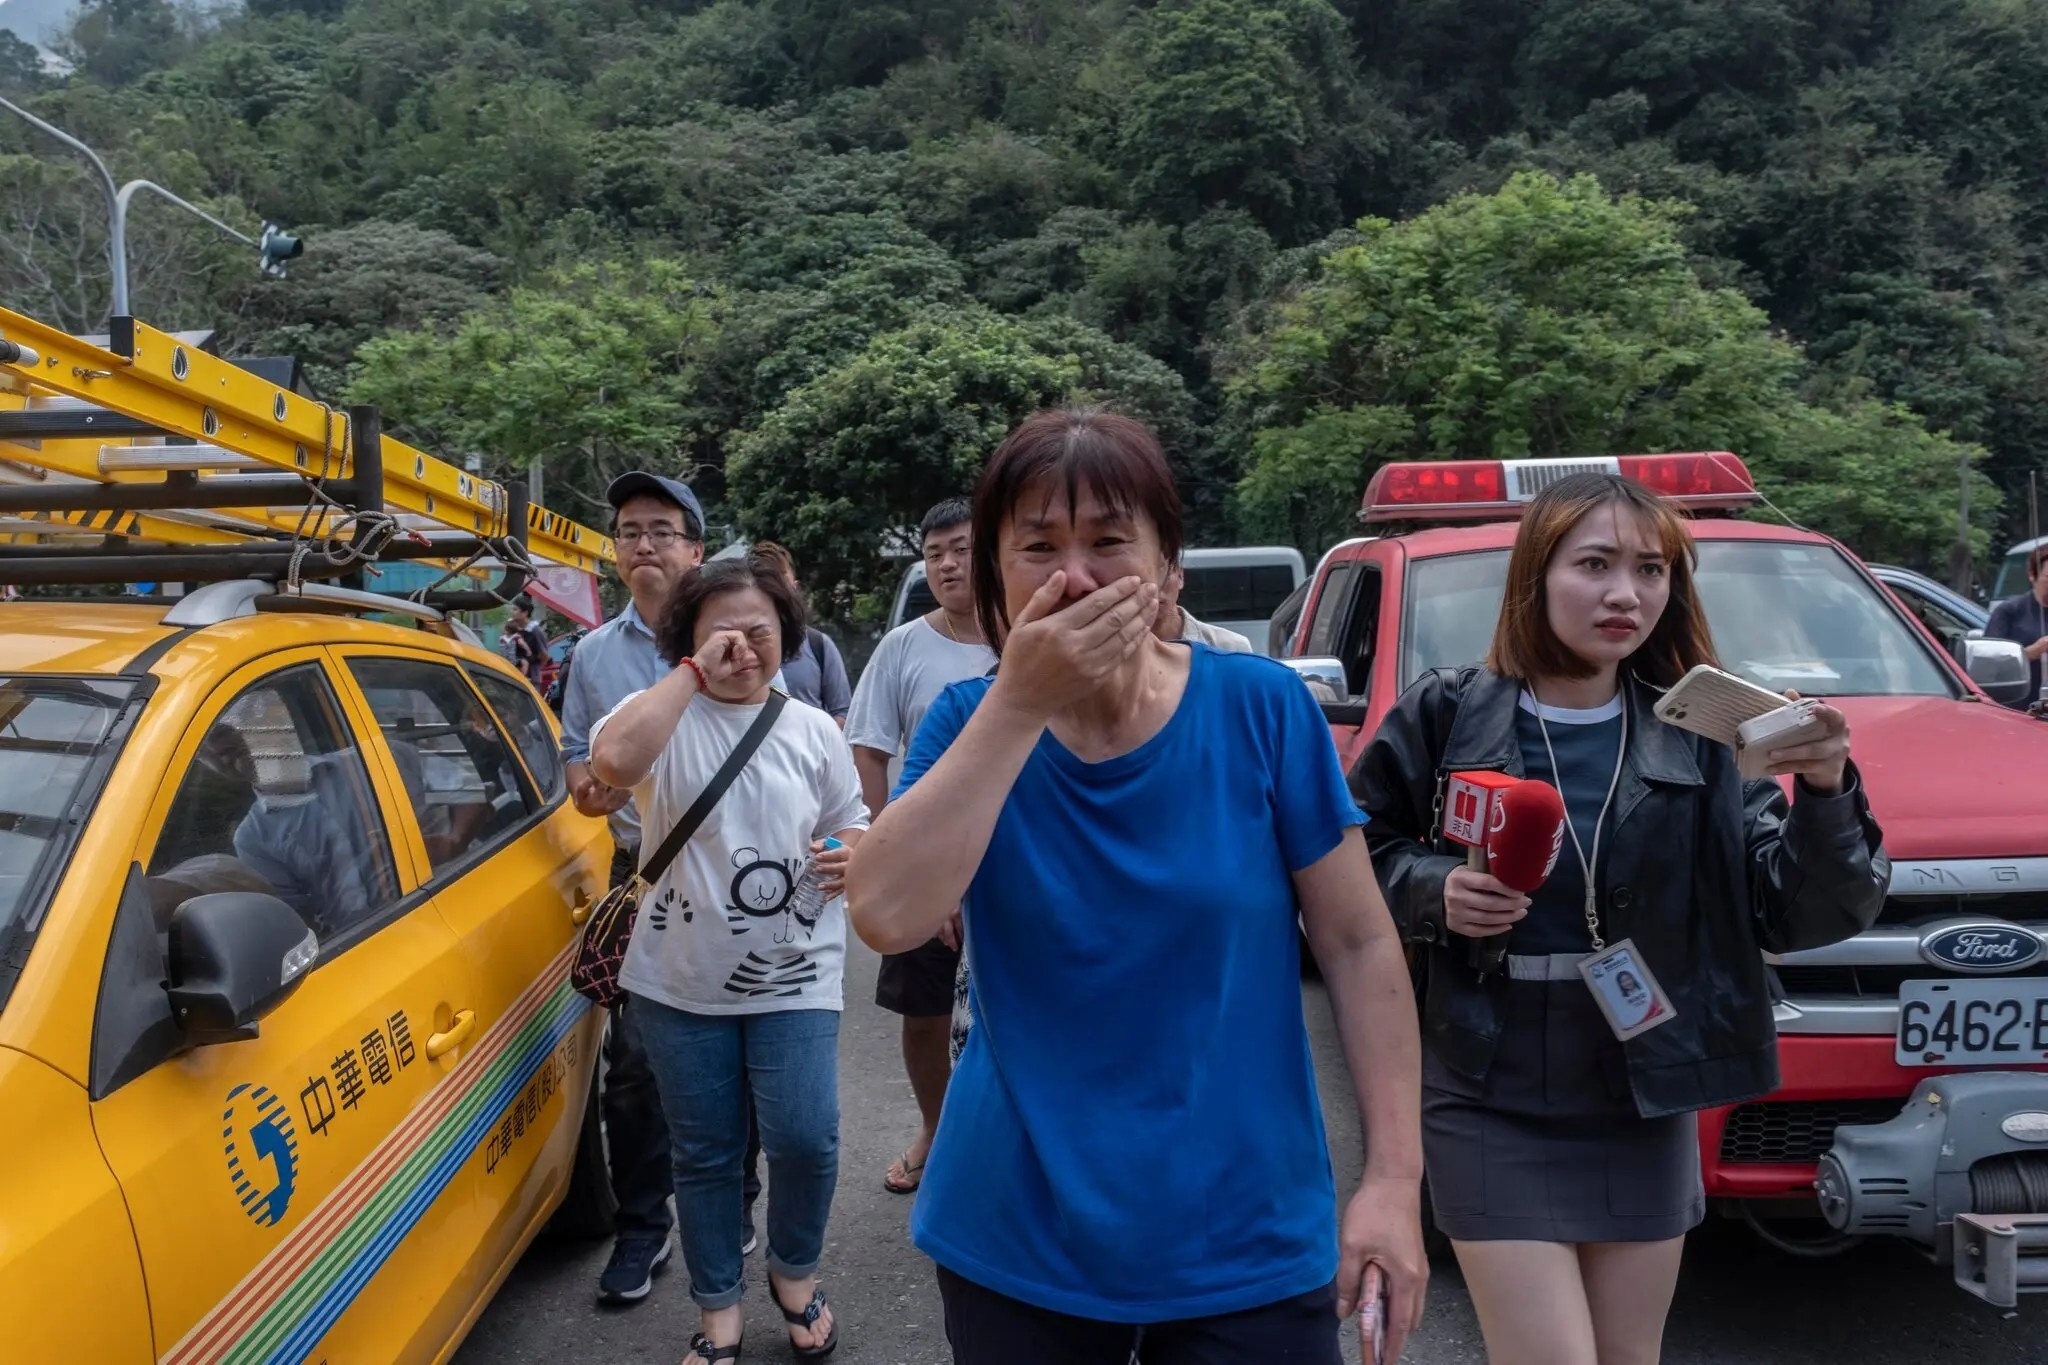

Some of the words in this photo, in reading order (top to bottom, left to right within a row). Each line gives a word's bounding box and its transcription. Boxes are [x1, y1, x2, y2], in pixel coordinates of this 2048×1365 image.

[1452, 819, 1473, 839] 非凡
[1952, 932, 2019, 959] Ford
[300, 1009, 416, 1137] 中華電信
